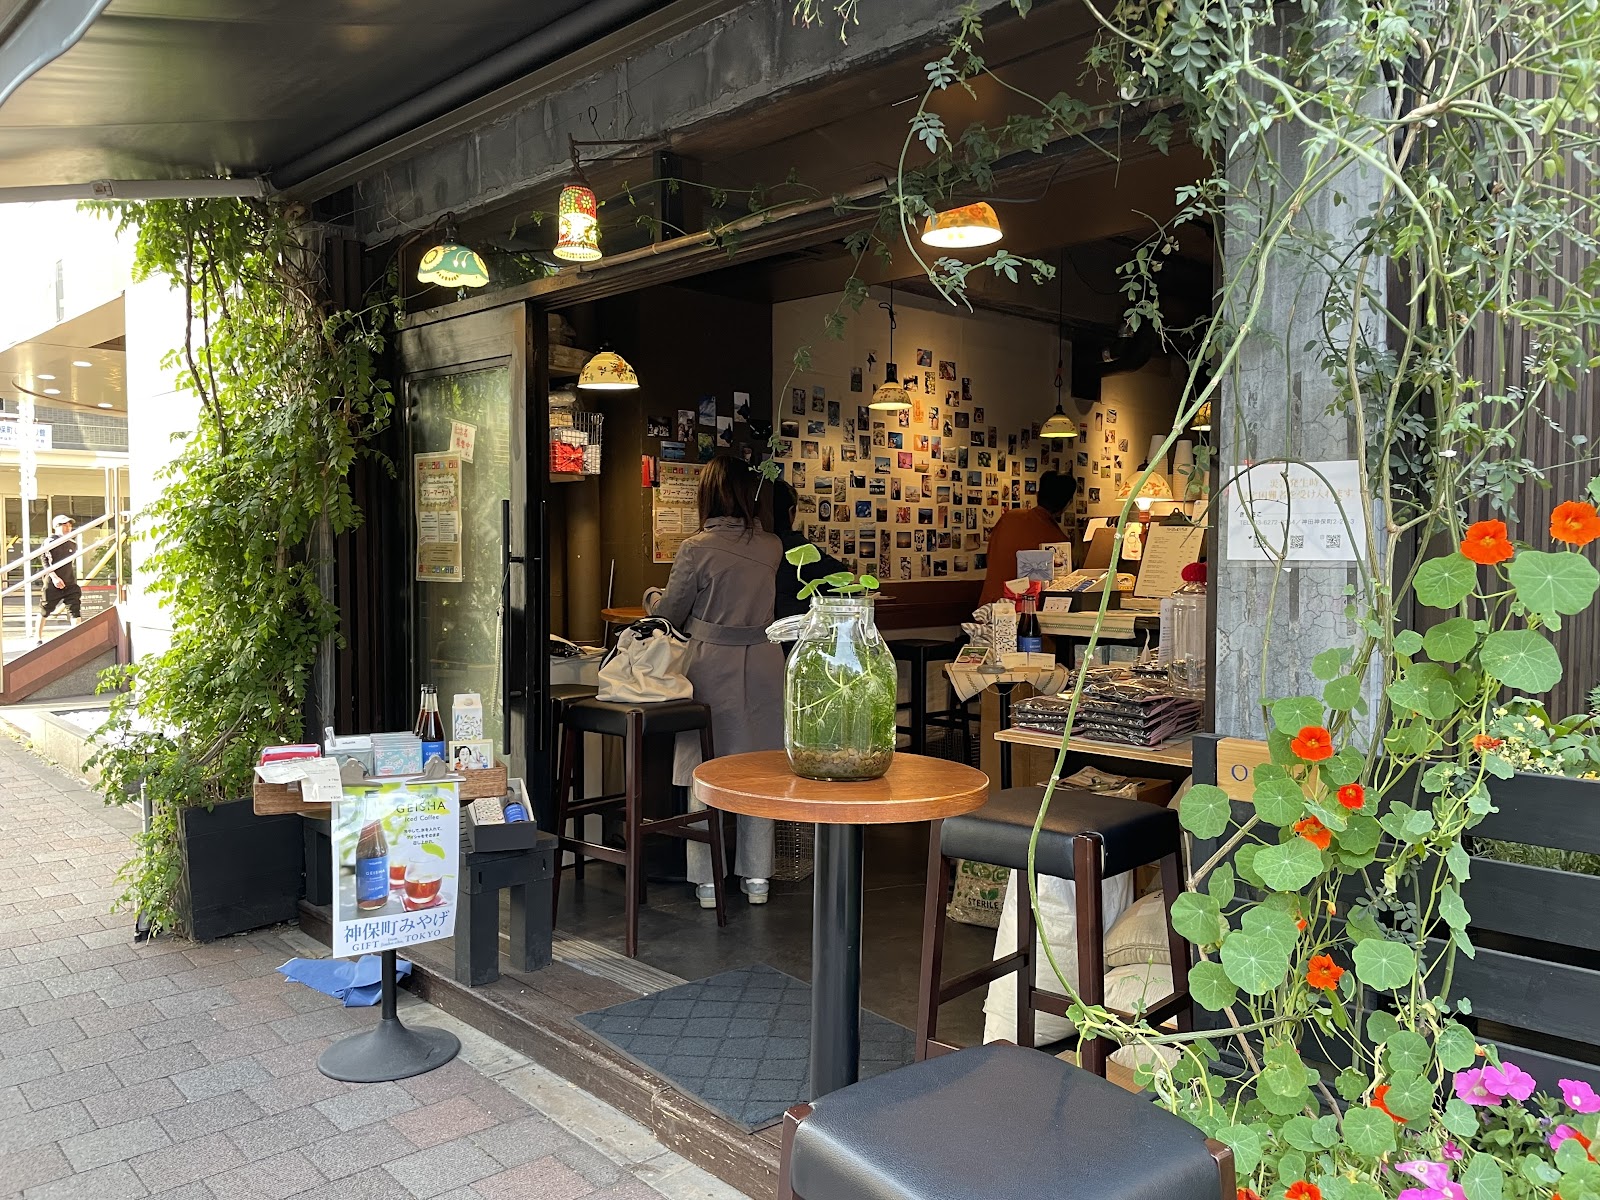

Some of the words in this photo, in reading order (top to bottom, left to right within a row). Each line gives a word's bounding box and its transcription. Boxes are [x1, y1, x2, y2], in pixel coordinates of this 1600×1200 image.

[396, 801, 446, 813] GEISHA
[968, 897, 999, 909] STERILE
[344, 910, 450, 943] 神保町みやげ
[352, 940, 380, 951] GIFT
[405, 929, 441, 942] TOKYO
